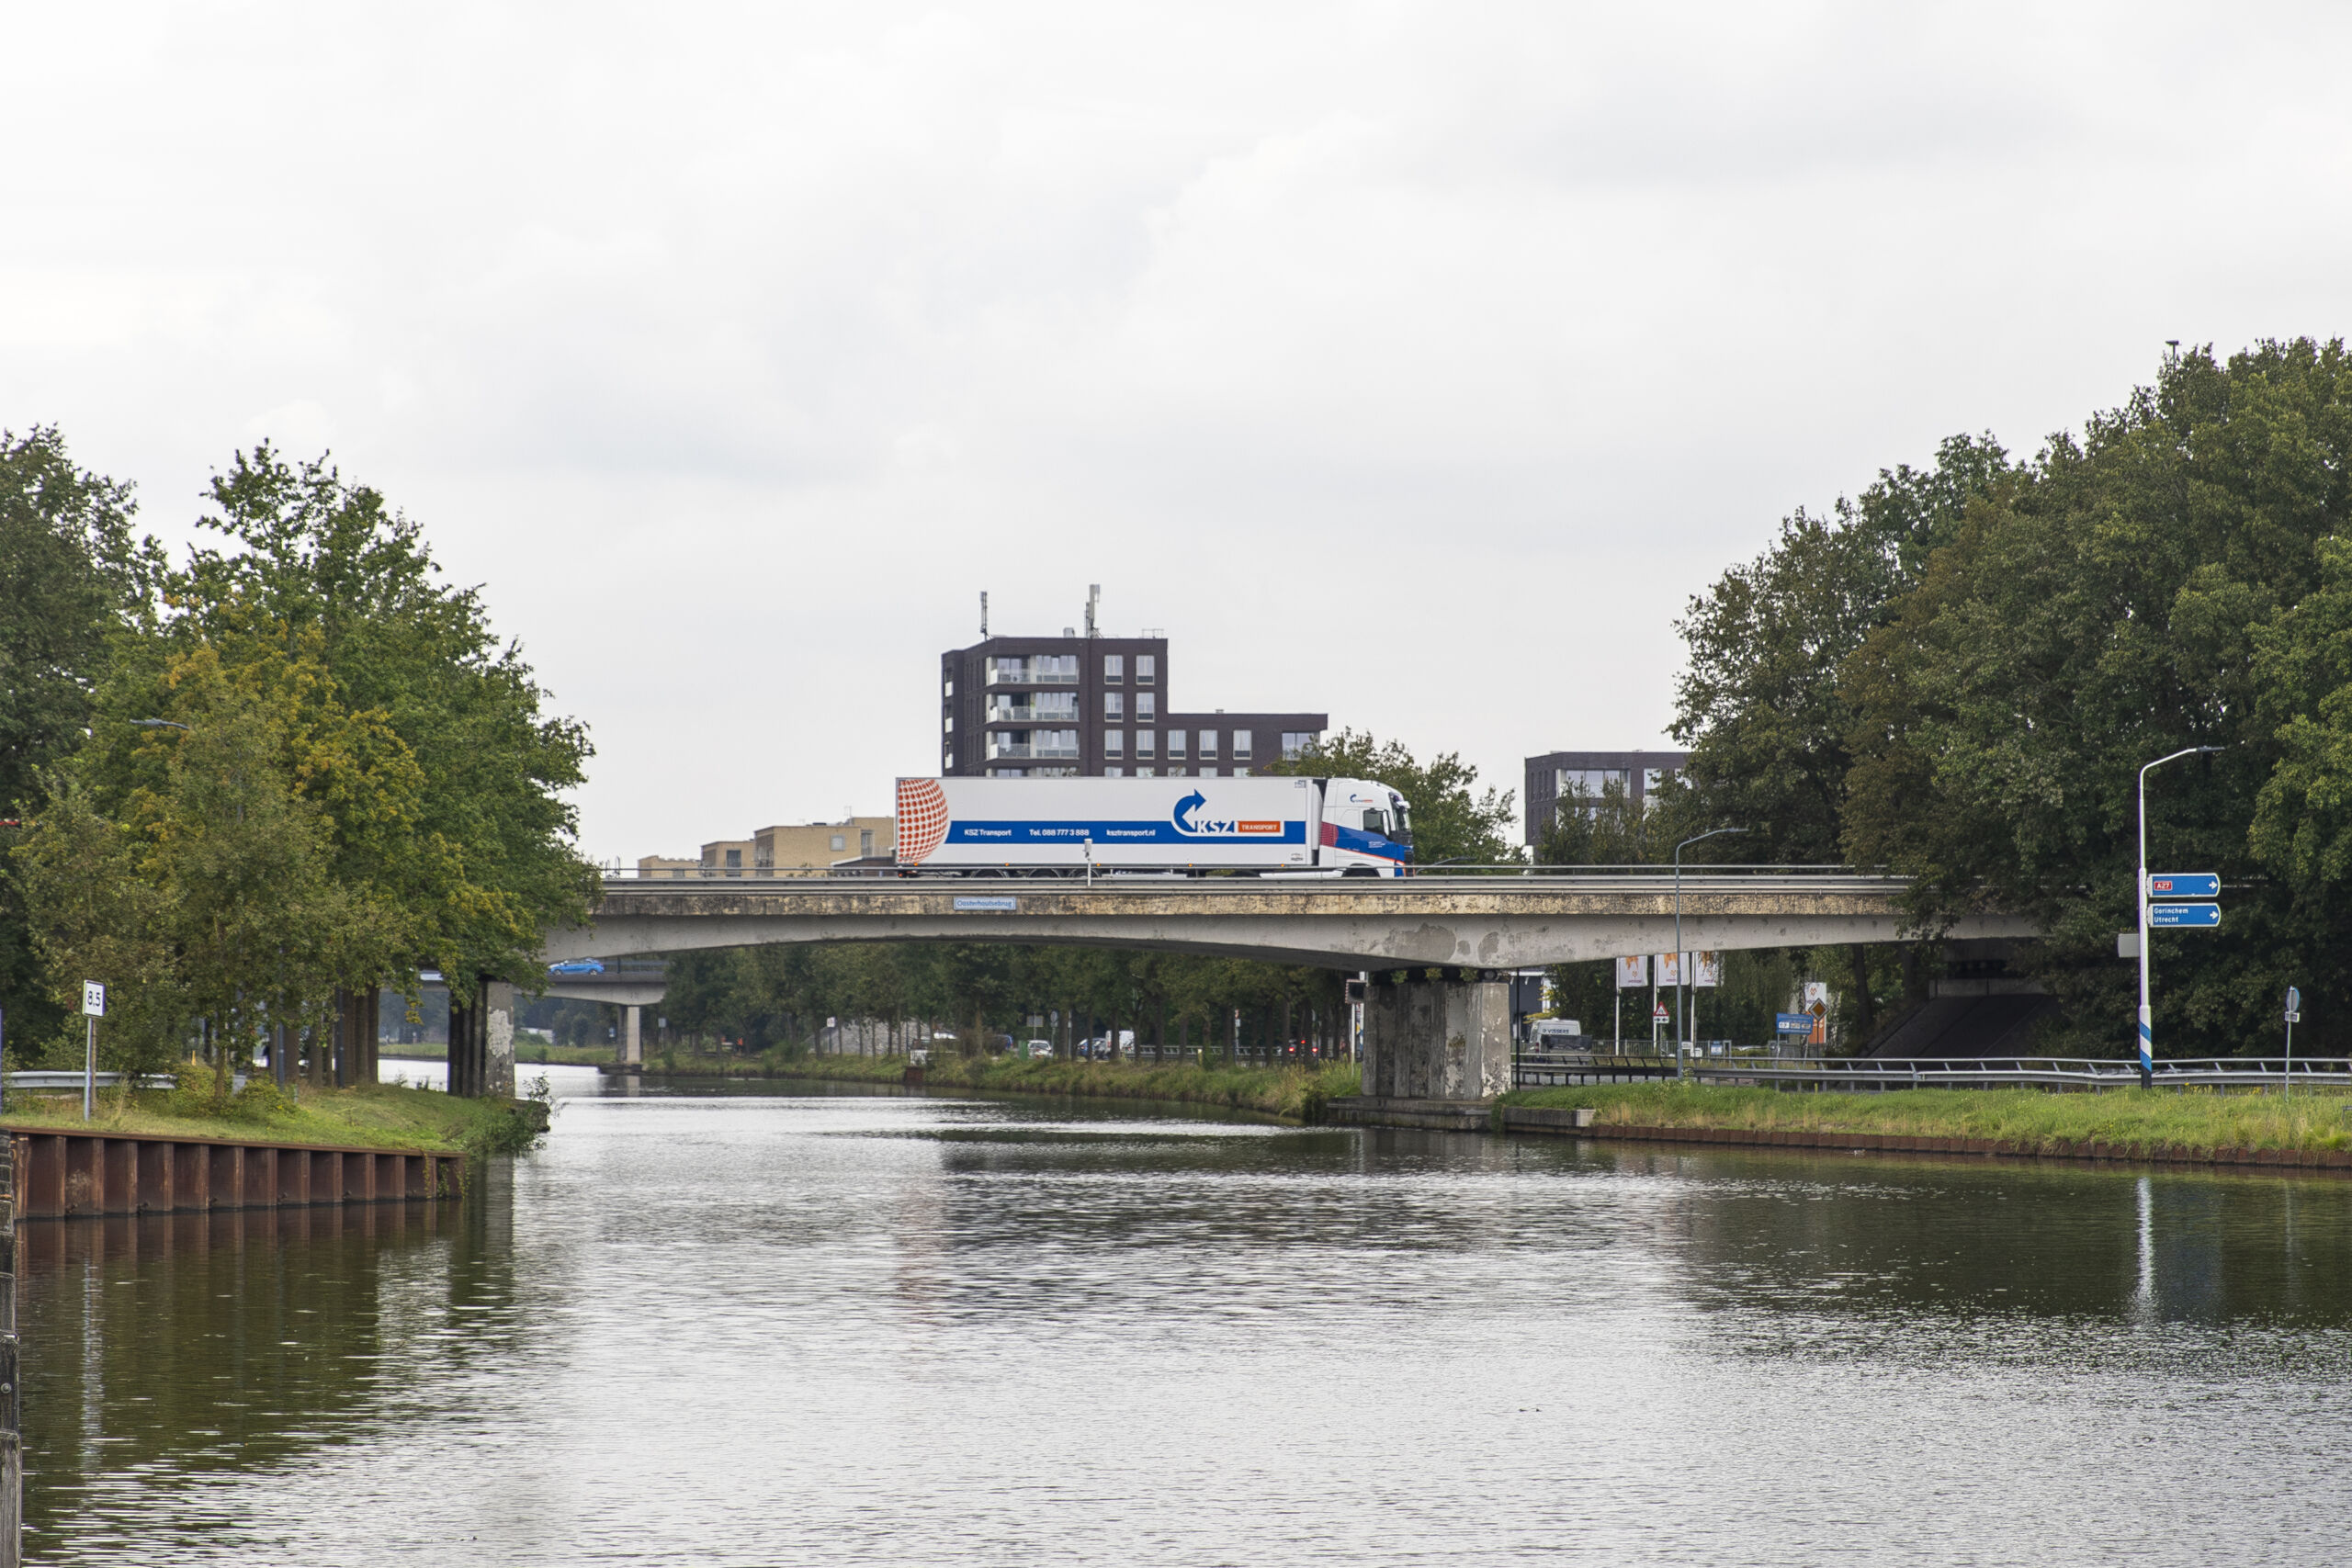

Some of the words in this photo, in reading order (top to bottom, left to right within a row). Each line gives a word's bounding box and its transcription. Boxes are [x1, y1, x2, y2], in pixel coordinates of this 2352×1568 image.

[1197, 820, 1234, 833] KSZ
[964, 829, 978, 837] KSZ
[979, 829, 1012, 838] Transport
[1106, 829, 1156, 838] ksztransport.nl
